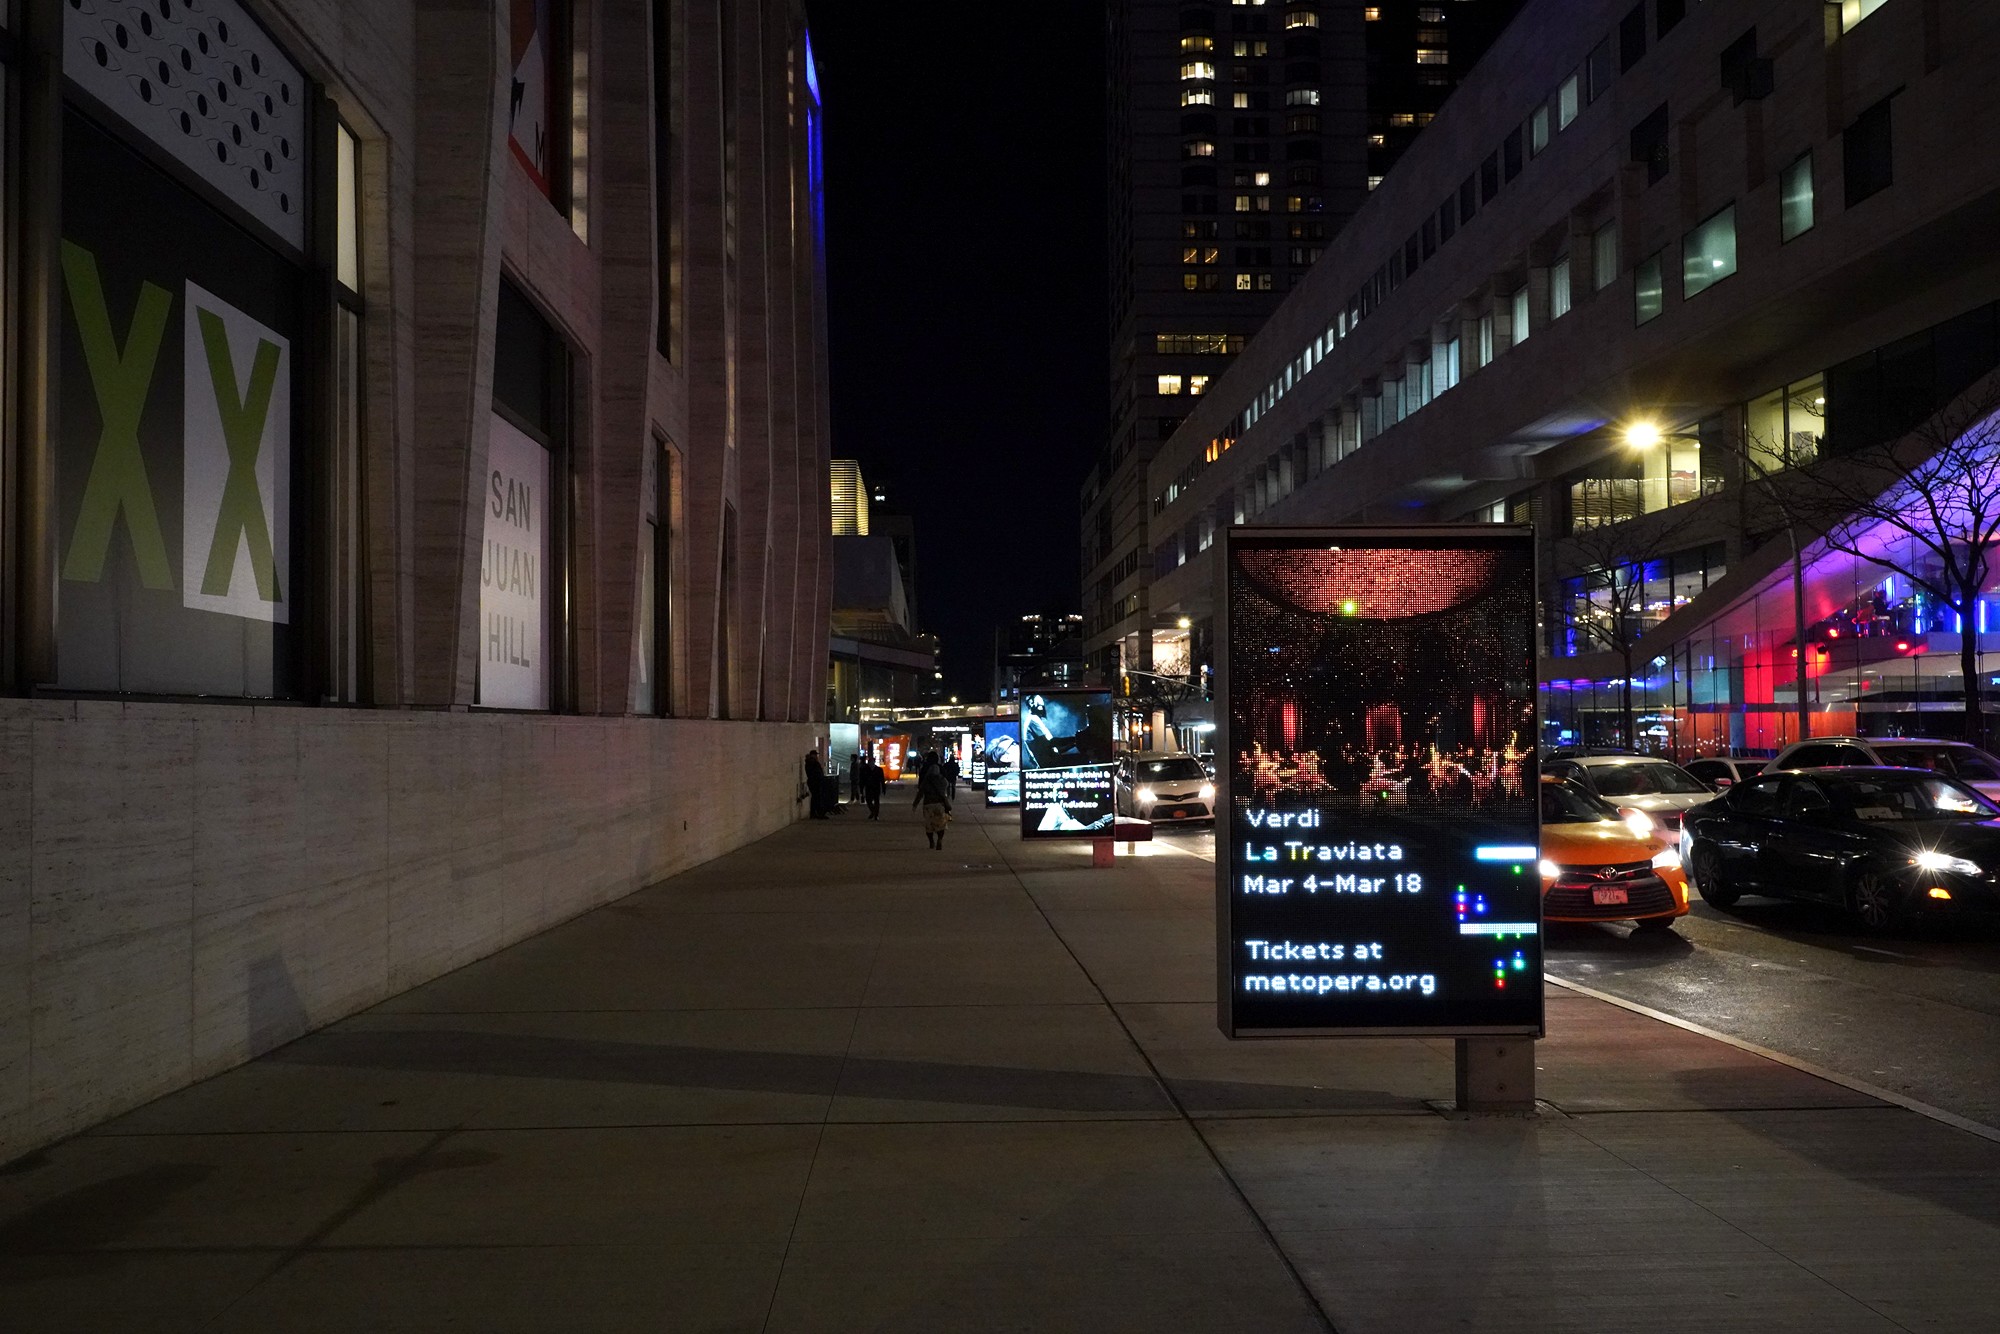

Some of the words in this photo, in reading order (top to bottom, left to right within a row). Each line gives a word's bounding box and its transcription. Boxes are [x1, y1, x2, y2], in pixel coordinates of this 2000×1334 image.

[491, 470, 530, 532] SAN
[482, 539, 535, 600] JUAN
[488, 612, 530, 668] HILL
[1025, 791, 1042, 799] Feb
[1244, 806, 1323, 829] Verdi
[1244, 842, 1278, 863] La
[1282, 841, 1404, 863] Traviata
[1241, 874, 1295, 896] Mar
[1394, 873, 1424, 895] 18
[1244, 939, 1346, 962] Tickets
[1352, 941, 1383, 962] at
[1242, 972, 1438, 999] metopera.org
